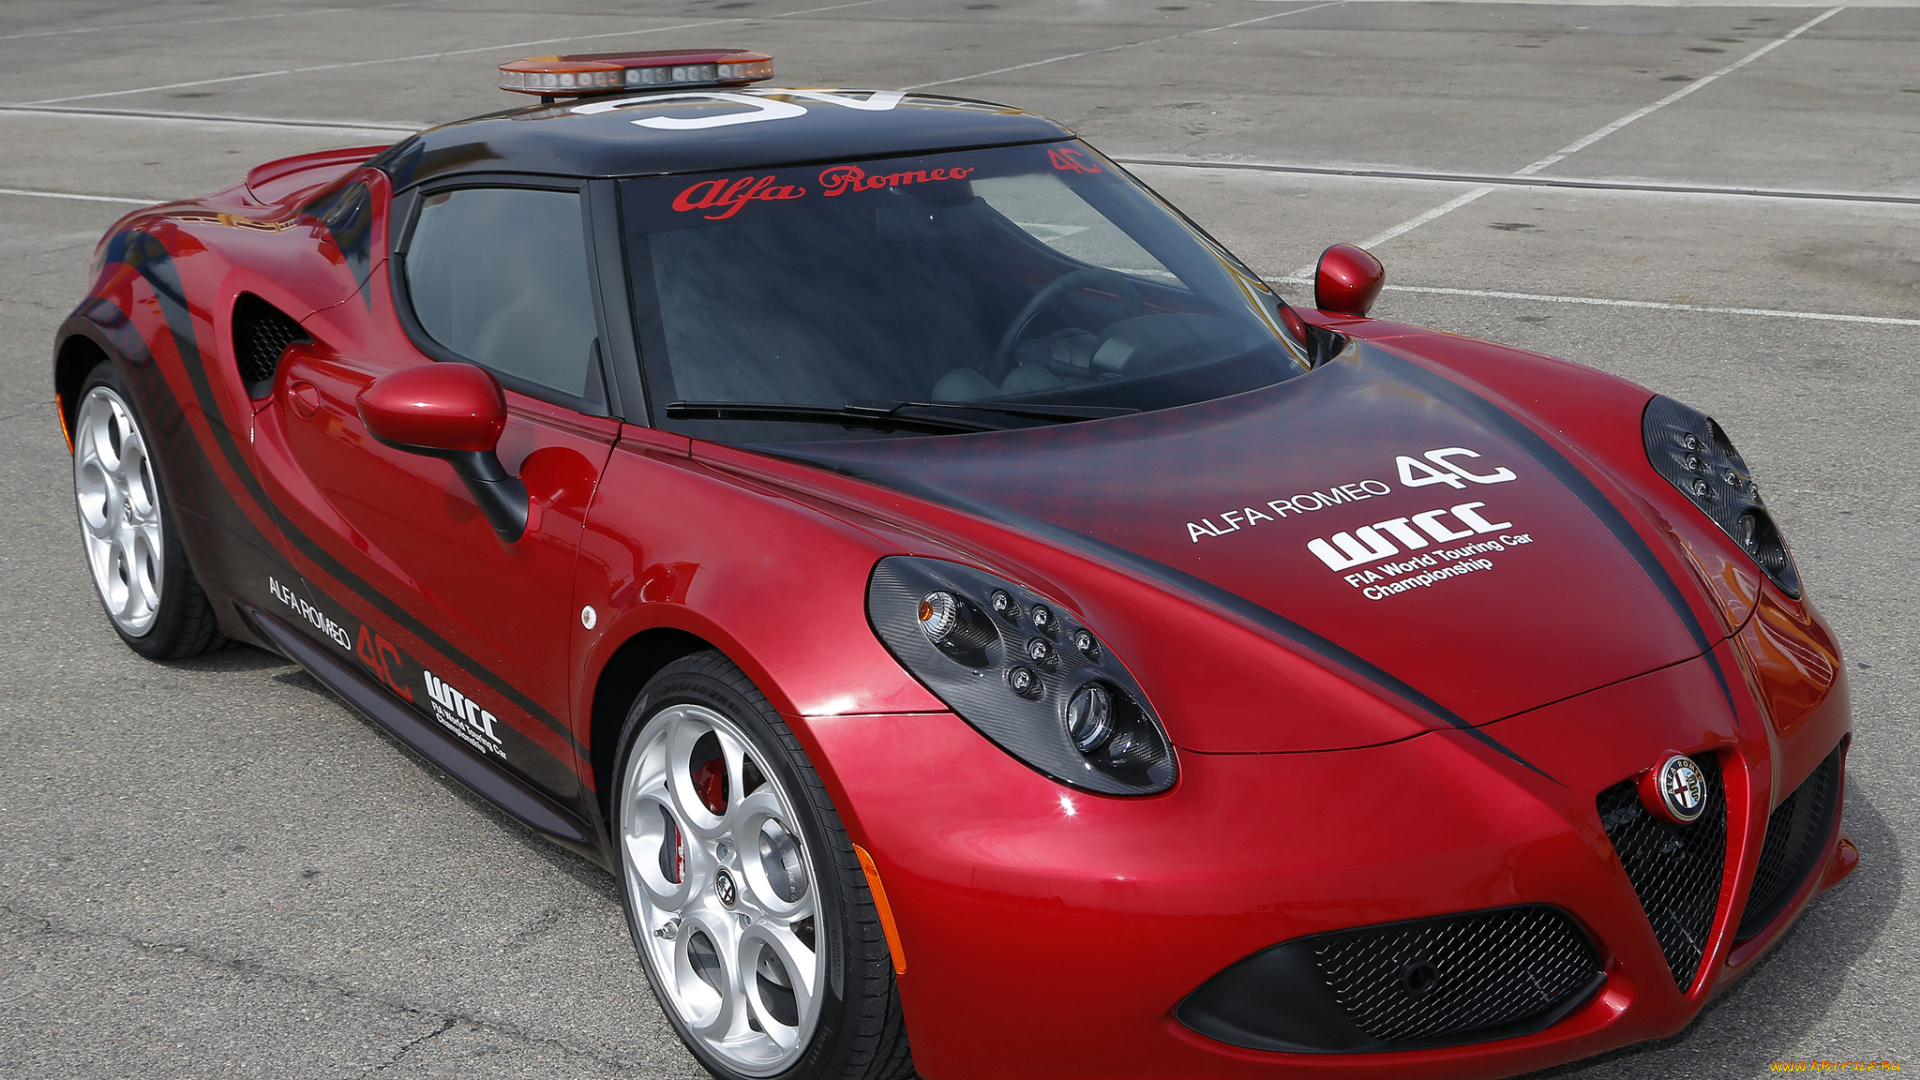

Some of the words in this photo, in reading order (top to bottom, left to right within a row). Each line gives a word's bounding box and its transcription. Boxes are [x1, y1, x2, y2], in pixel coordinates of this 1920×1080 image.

[1048, 147, 1101, 174] 4C
[672, 174, 807, 220] Alfa
[818, 165, 975, 197] Romeo
[1186, 506, 1268, 543] ALFA
[1267, 479, 1392, 519] ROMEO
[1395, 446, 1518, 490] 4C
[1306, 501, 1514, 573] WTCC
[1344, 570, 1383, 589] FIA
[1380, 553, 1437, 580] World
[1434, 538, 1503, 565] Touring
[1500, 531, 1534, 548] Car
[1362, 556, 1494, 602] Championship
[268, 576, 302, 615] ALFA
[300, 598, 352, 651] ROMEO
[356, 624, 414, 704] 4C
[424, 670, 502, 745] WTCC
[1667, 767, 1677, 795] ALFA
